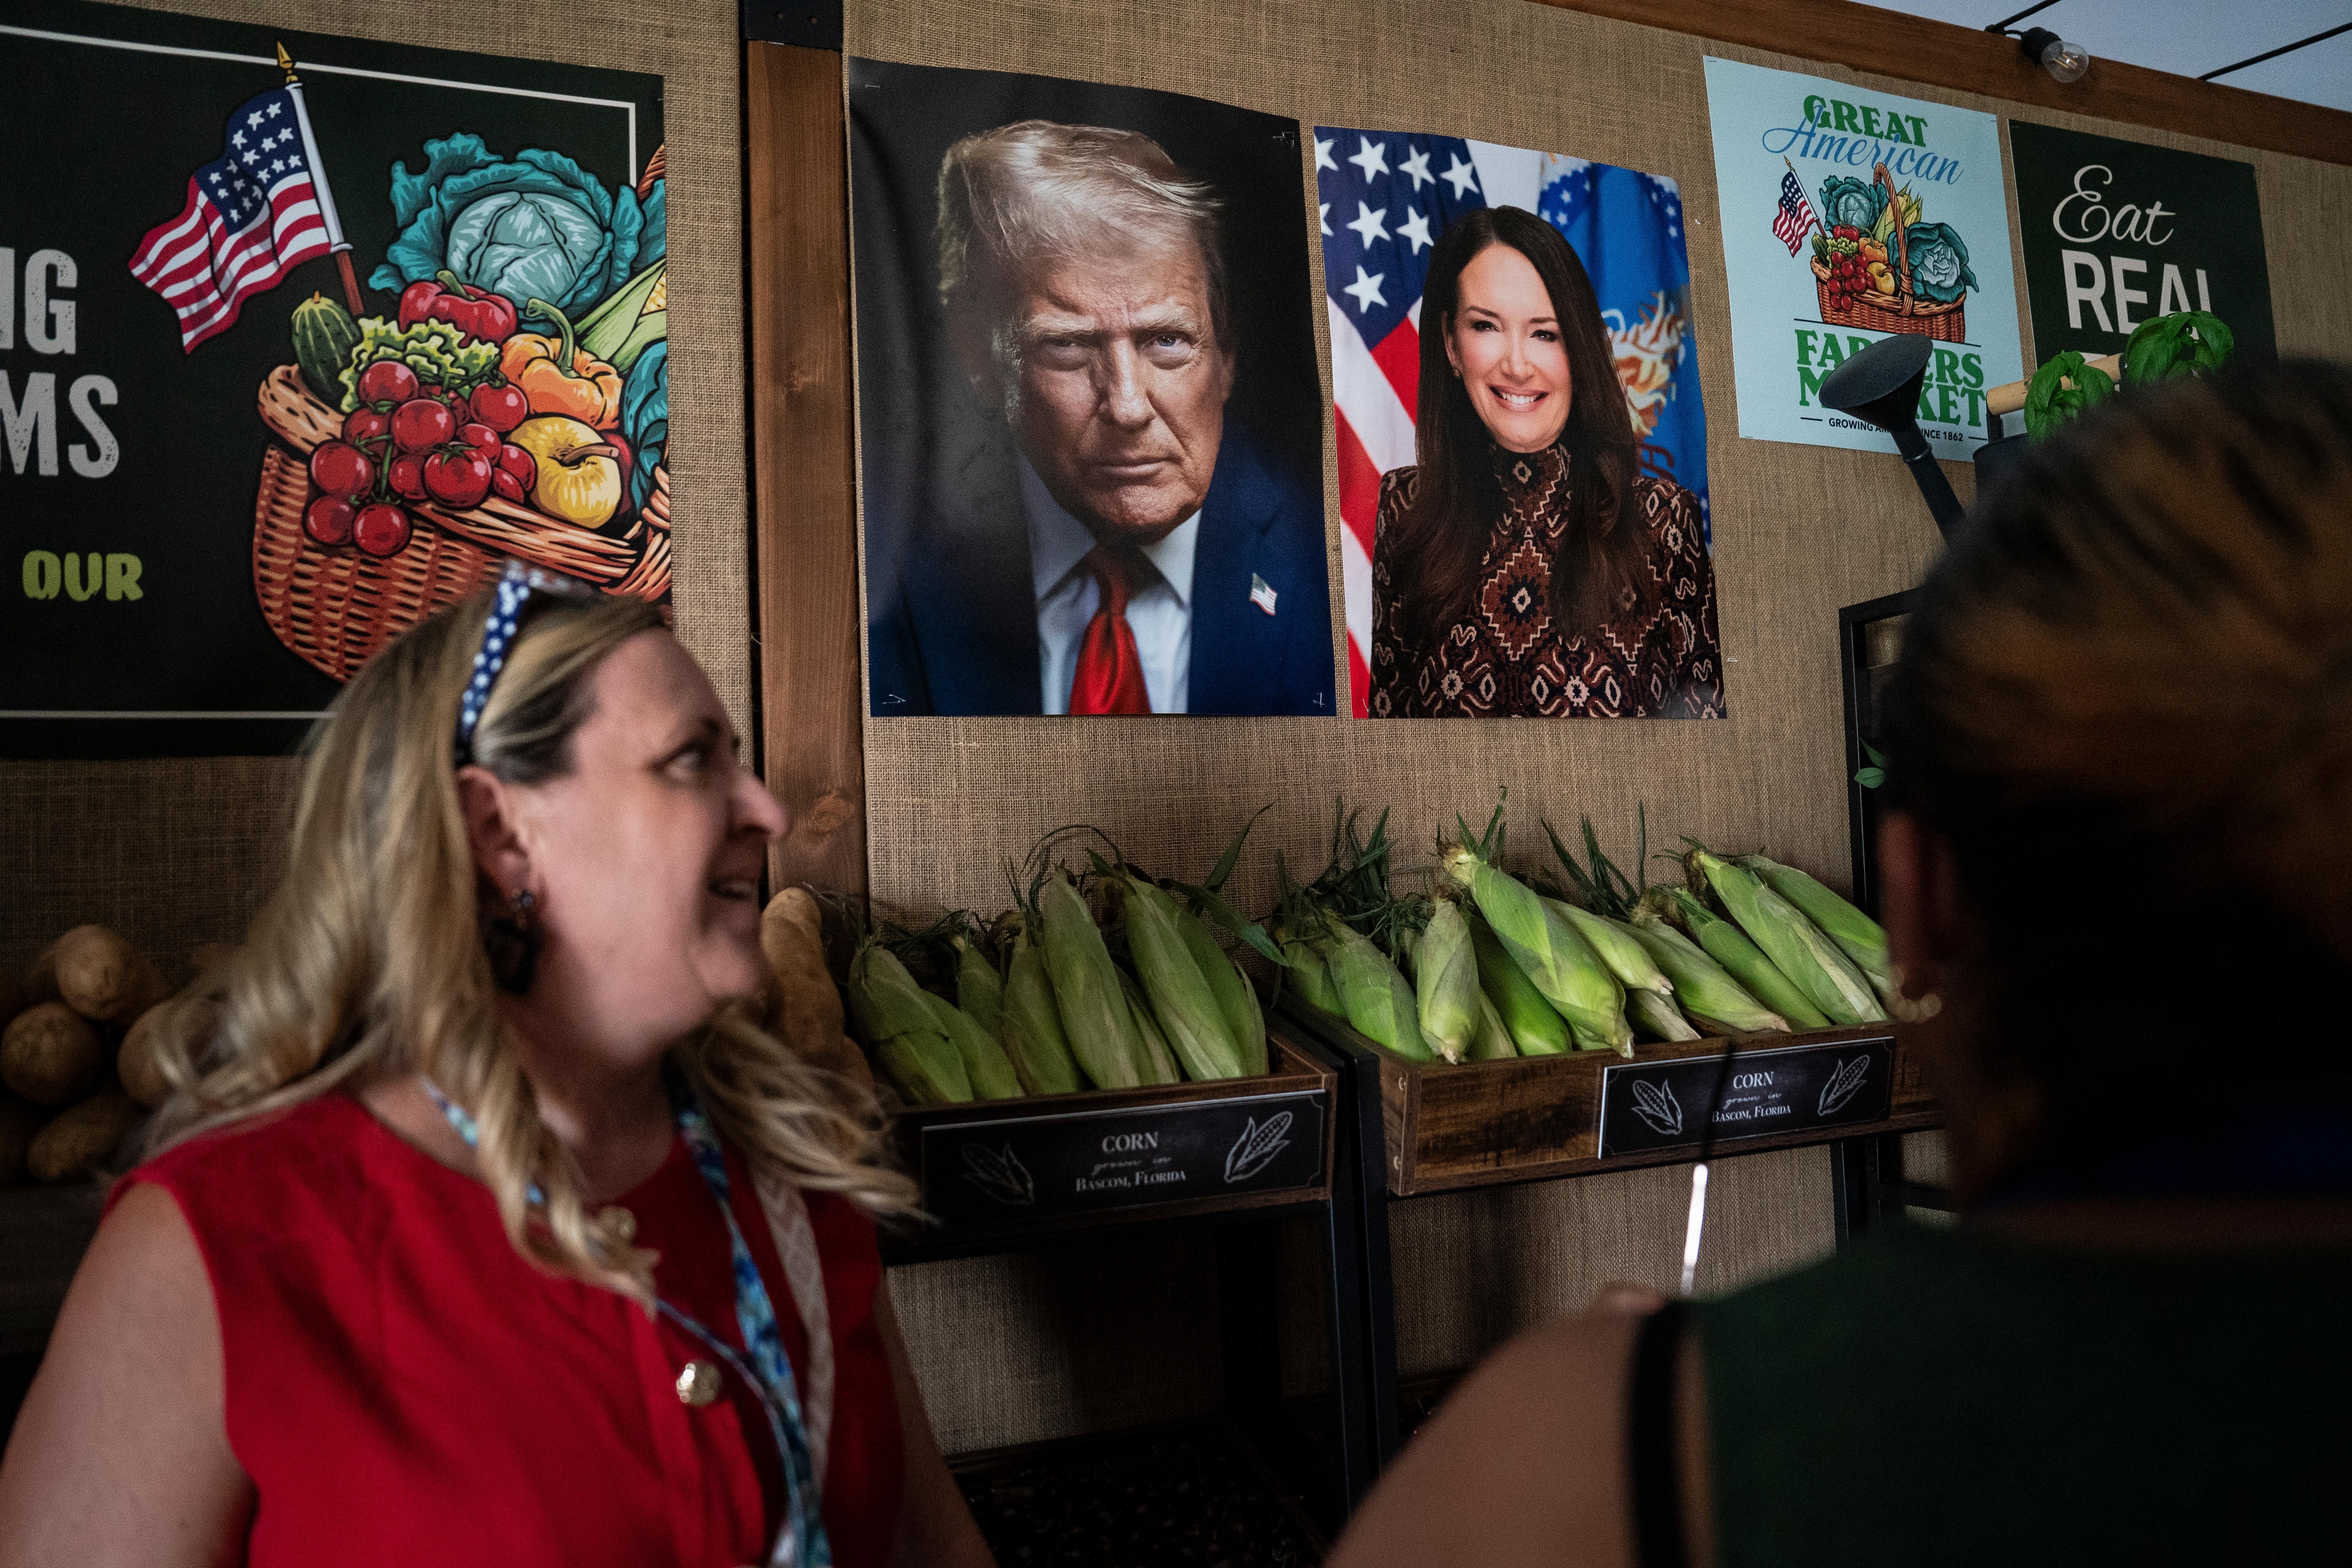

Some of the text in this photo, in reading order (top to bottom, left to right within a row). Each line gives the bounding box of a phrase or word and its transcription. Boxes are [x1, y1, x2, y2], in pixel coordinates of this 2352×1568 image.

[1763, 104, 1964, 185] American
[1803, 94, 1928, 147] GREAT
[2053, 165, 2176, 245] Eat
[1797, 366, 1985, 427] MKET
[1829, 418, 1873, 431] GROWING
[1922, 428, 1941, 439] NCE
[1943, 431, 1963, 441] 1862
[22, 550, 144, 602] OUR
[1723, 1095, 1761, 1110] grown
[1733, 1071, 1775, 1089] CORN
[1101, 1131, 1159, 1154] CORN
